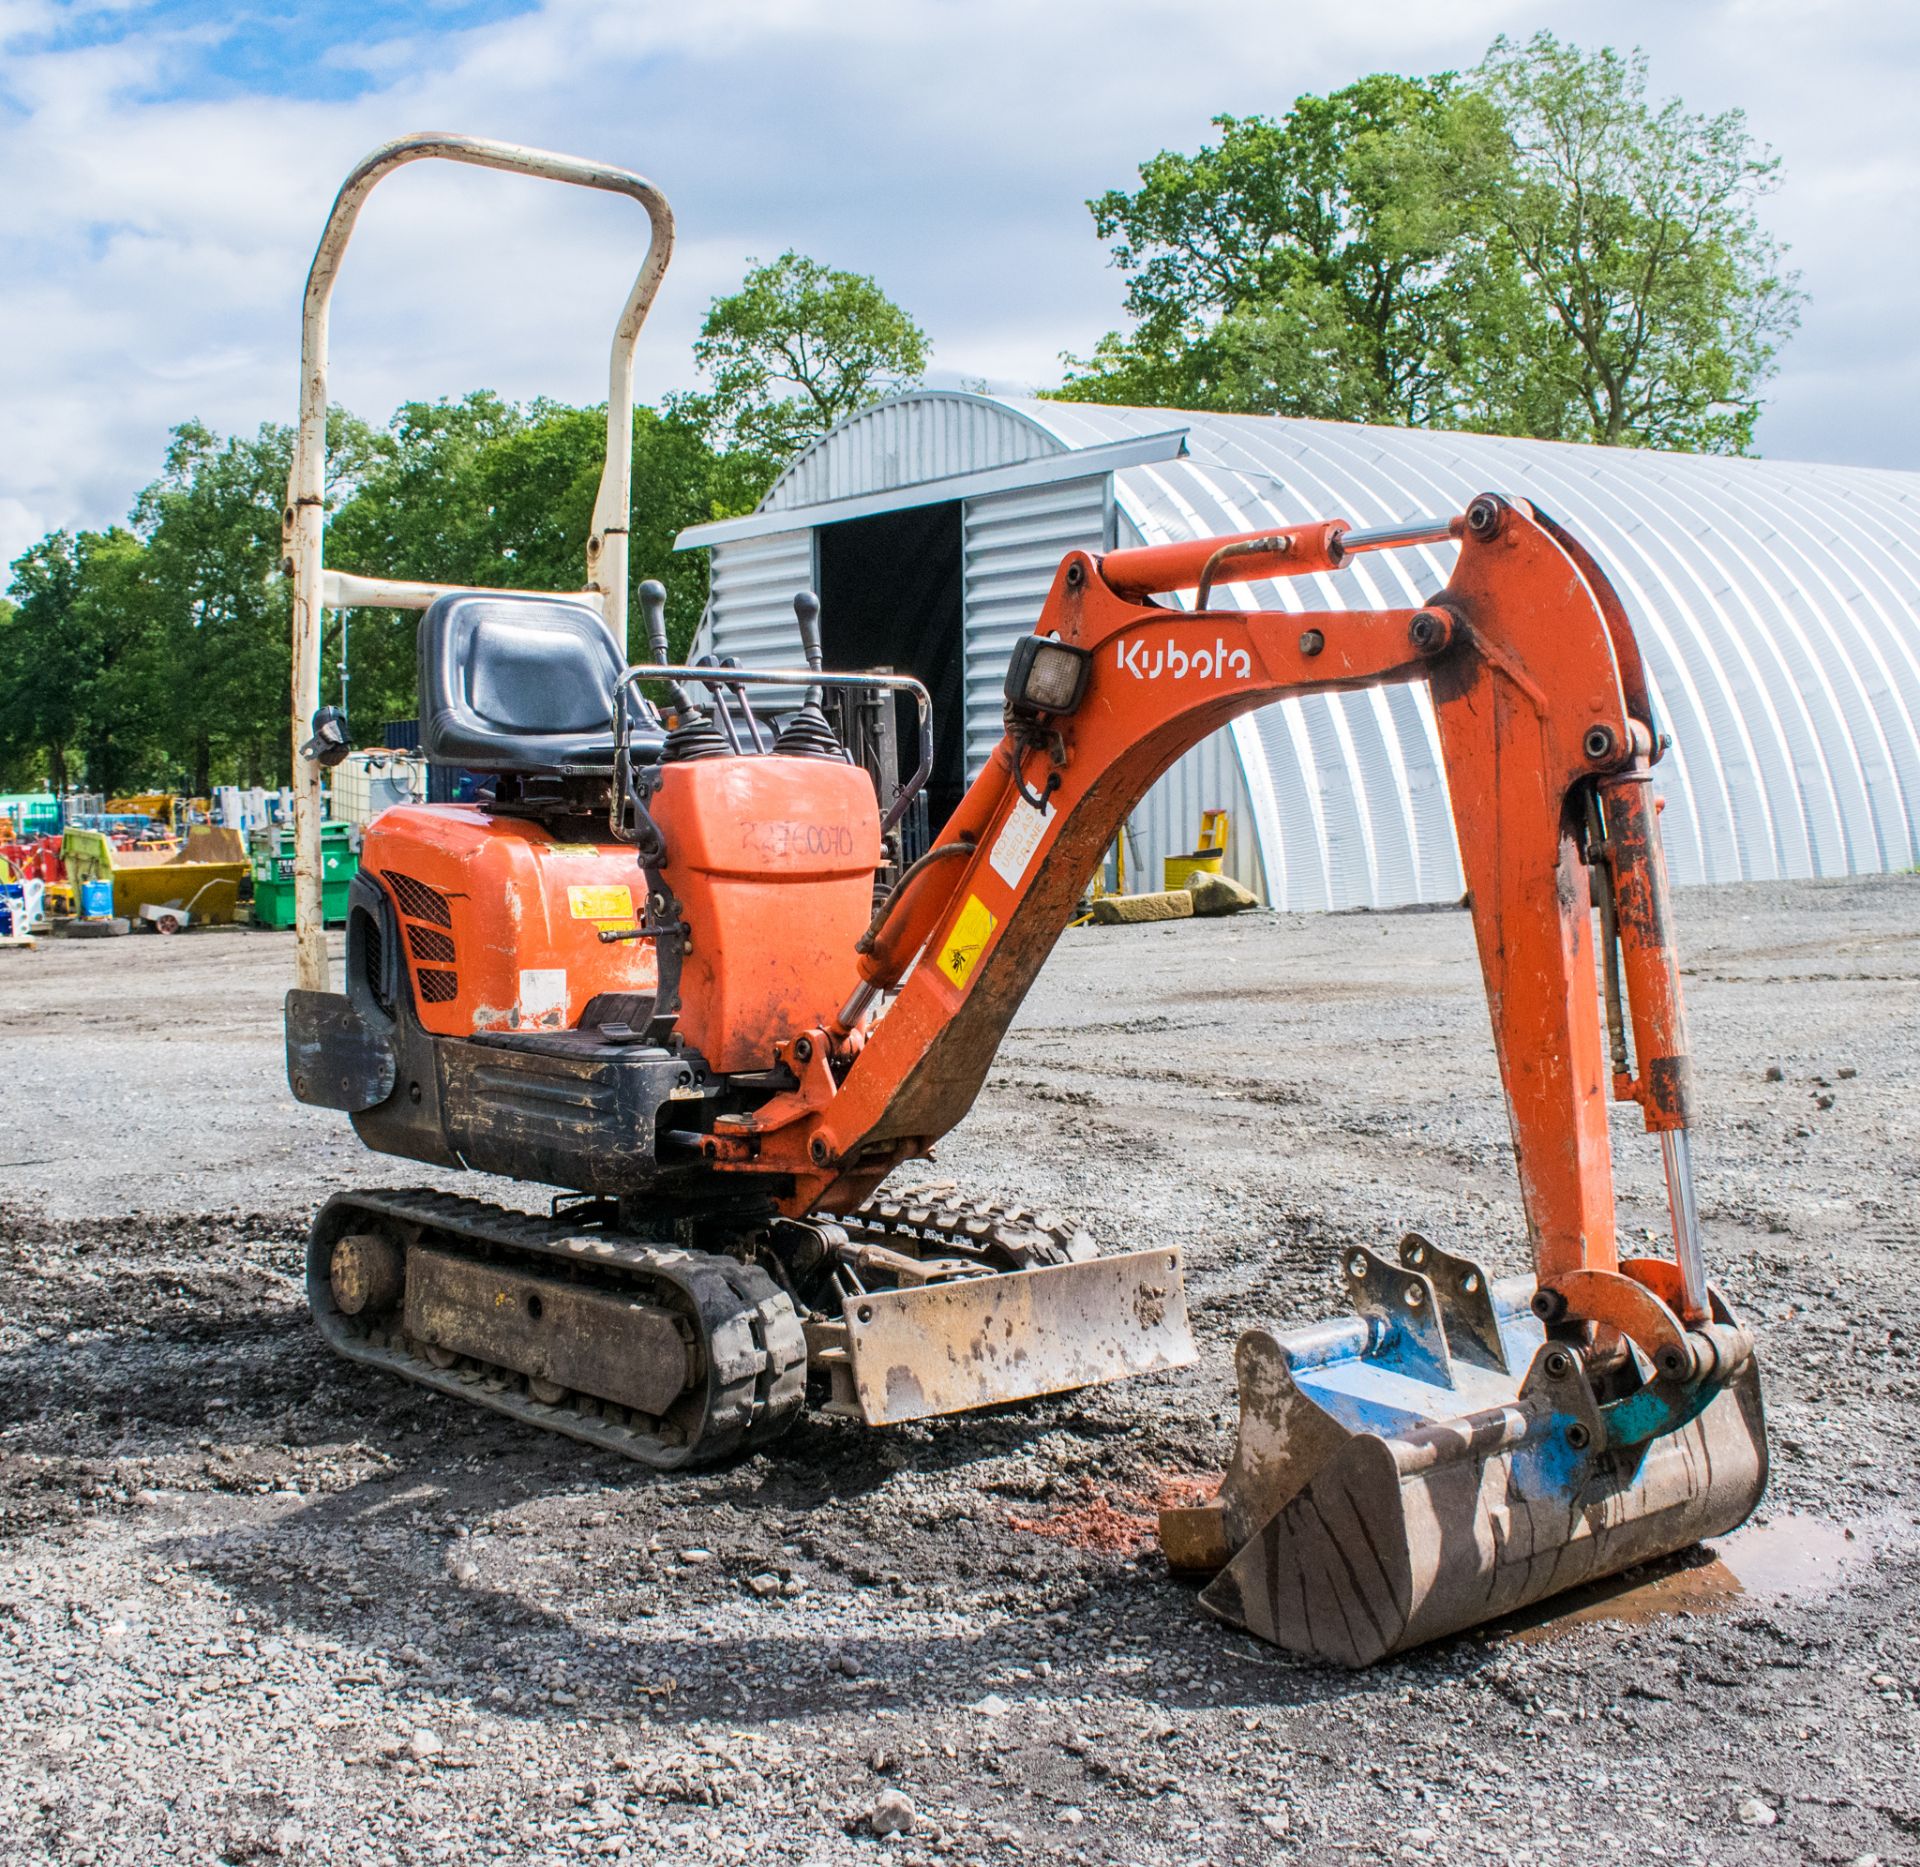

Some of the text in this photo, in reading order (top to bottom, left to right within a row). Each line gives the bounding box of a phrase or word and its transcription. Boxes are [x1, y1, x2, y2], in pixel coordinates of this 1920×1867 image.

[1117, 638, 1251, 679] Kubota
[993, 832, 1009, 859] NOT
[1008, 812, 1021, 829] TO
[1002, 812, 1034, 867] USED AS
[1016, 823, 1043, 866] CRANE
